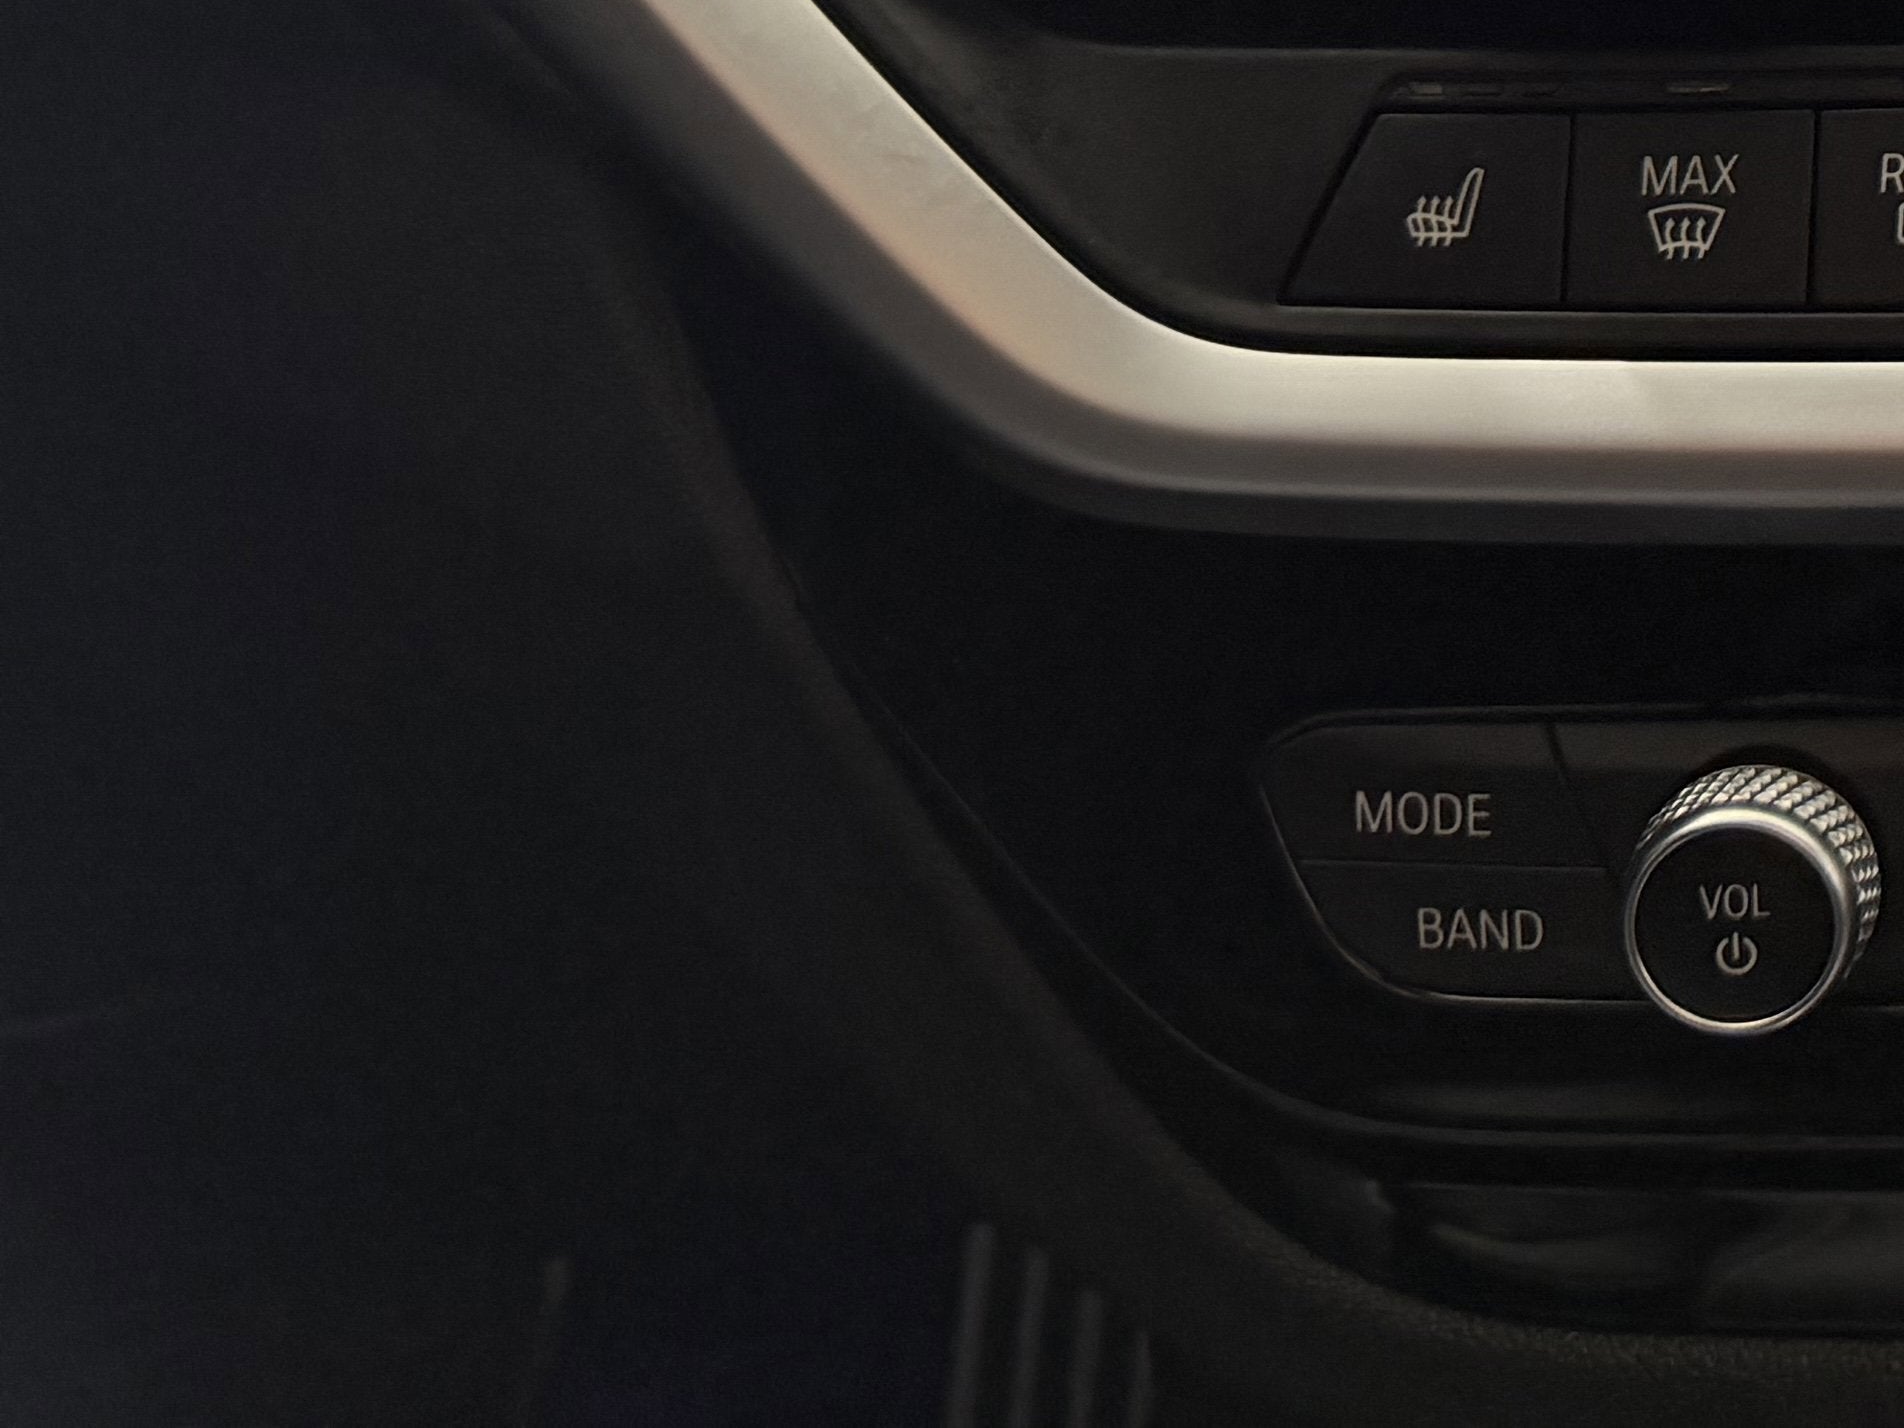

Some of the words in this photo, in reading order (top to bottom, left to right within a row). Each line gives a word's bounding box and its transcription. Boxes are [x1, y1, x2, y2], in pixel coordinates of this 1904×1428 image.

[1641, 153, 1739, 195] MAX
[1355, 791, 1491, 834] MODE
[1701, 884, 1770, 920] VOL
[1417, 907, 1543, 951] BAND
